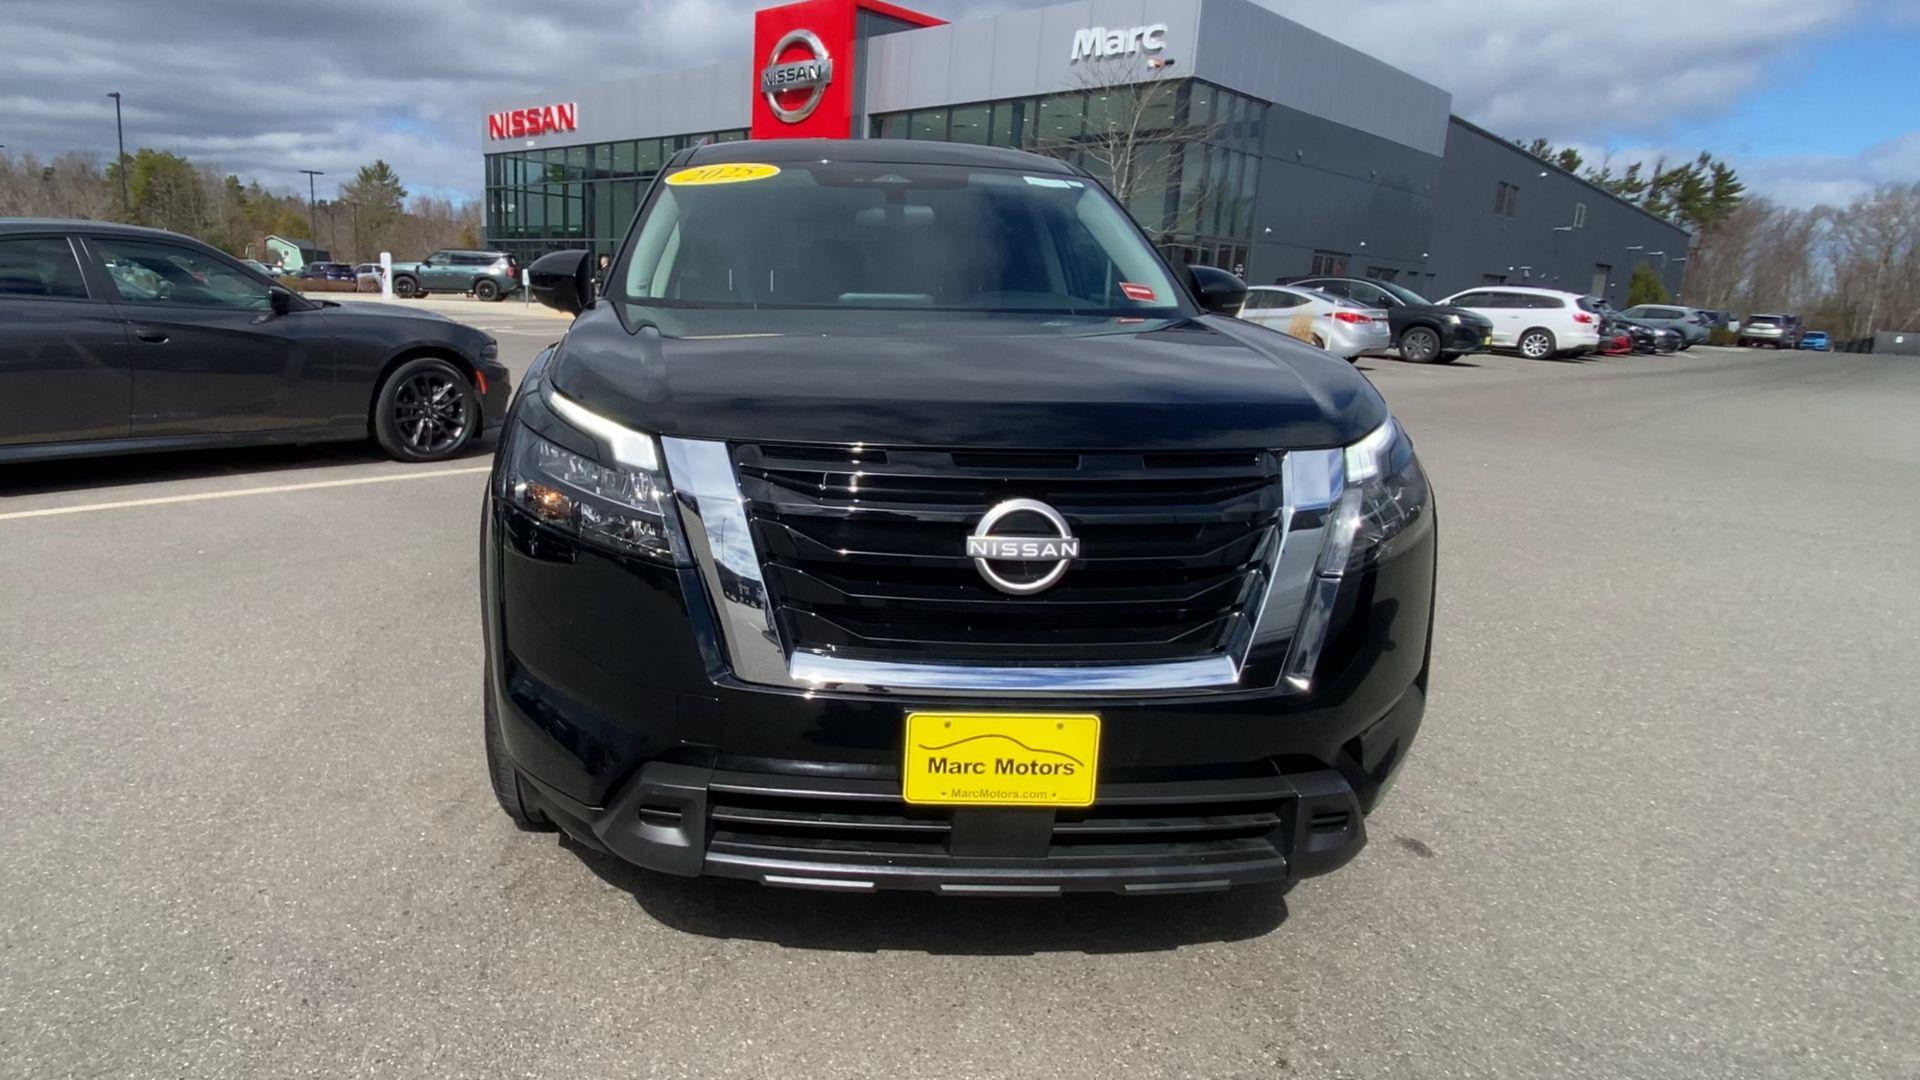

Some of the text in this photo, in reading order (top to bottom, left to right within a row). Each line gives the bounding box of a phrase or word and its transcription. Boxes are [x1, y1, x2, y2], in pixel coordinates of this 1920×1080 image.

[1071, 24, 1167, 62] Marc
[765, 64, 822, 85] NISSAN
[488, 103, 577, 140] NISSAN
[969, 541, 1078, 557] NISSAN
[928, 757, 1075, 776] Marc Motors
[951, 788, 1047, 799] MarcMotors.com
